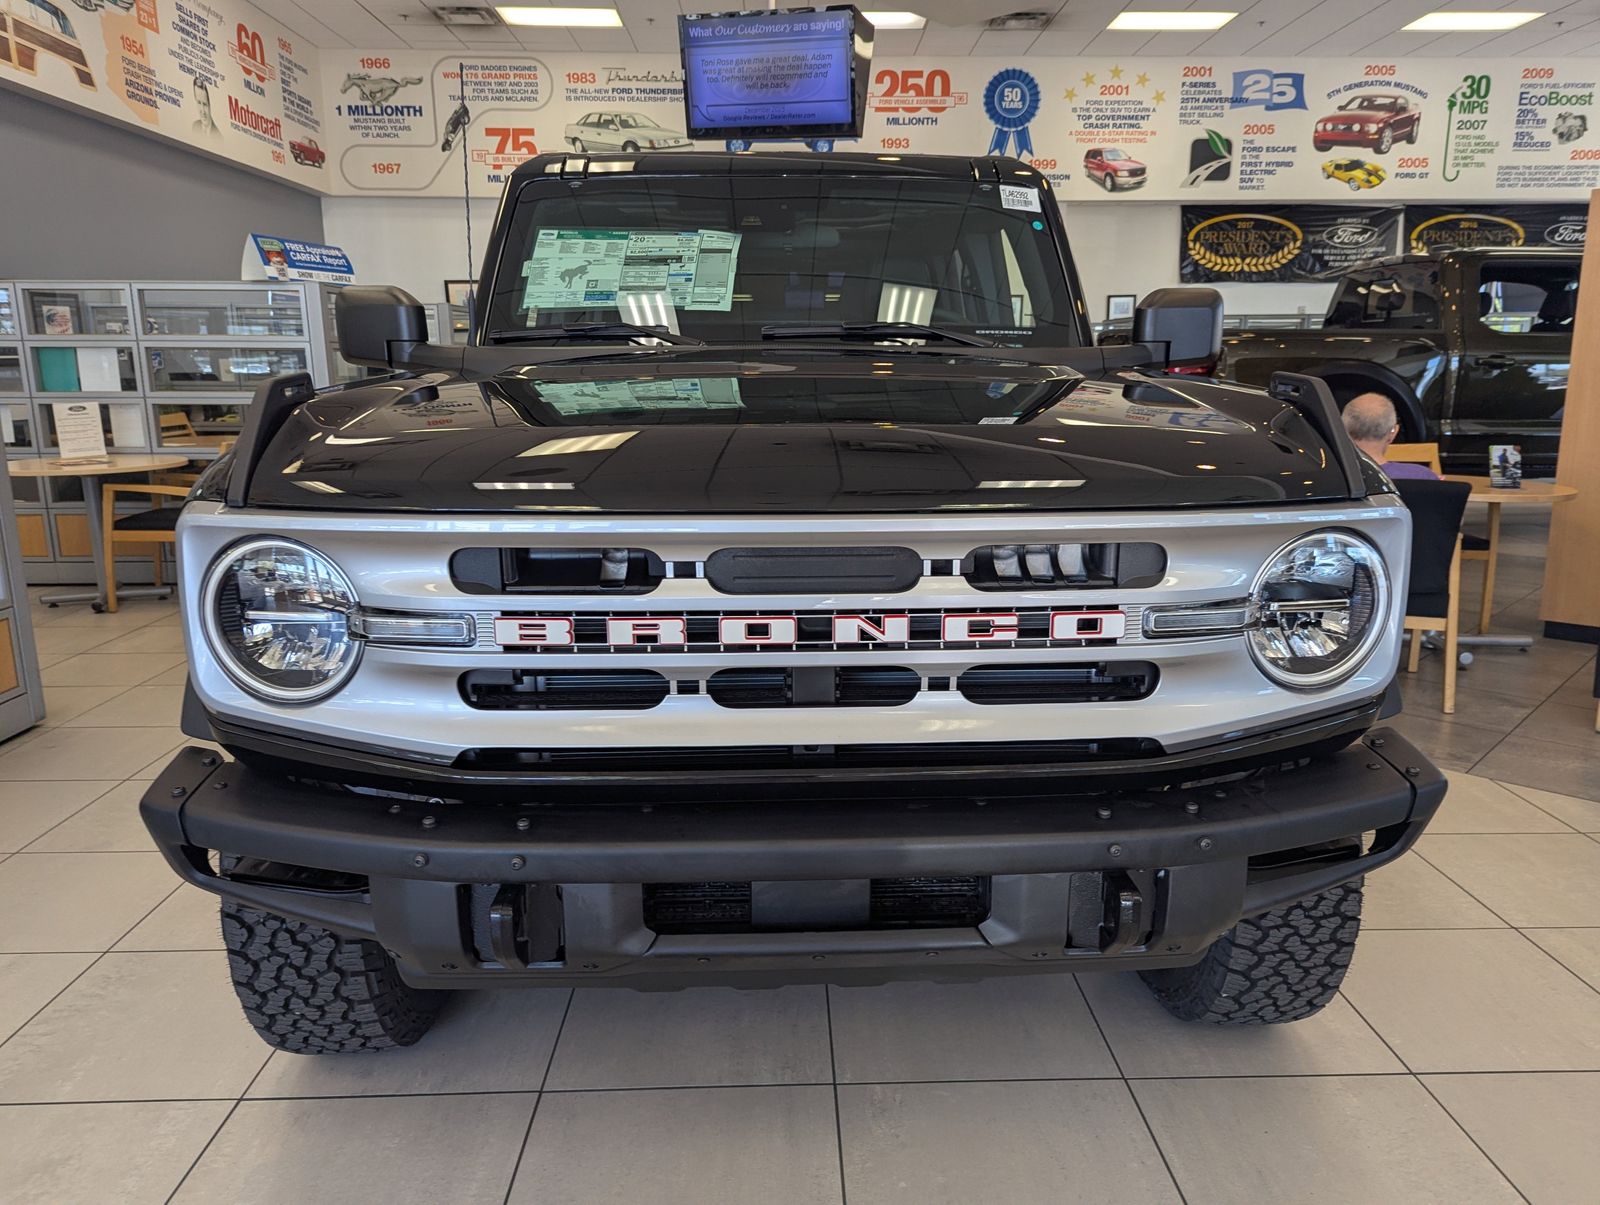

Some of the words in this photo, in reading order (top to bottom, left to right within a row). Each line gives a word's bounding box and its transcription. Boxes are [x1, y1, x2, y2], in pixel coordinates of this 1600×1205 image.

[175, 2, 194, 19] SELLS
[193, 13, 209, 28] FIRST
[178, 14, 200, 32] SHARES
[688, 26, 713, 38] What
[714, 25, 737, 37] Our
[737, 22, 792, 36] Customers
[793, 22, 809, 31] are
[809, 18, 845, 33] saying!
[171, 21, 198, 41] COMMON
[198, 36, 217, 52] STOCK
[120, 34, 145, 58] 1954
[236, 22, 266, 84] 60
[121, 55, 137, 69] FORD
[137, 61, 157, 77] BEGINS
[359, 57, 391, 69] 1966
[734, 57, 752, 67] gave
[752, 56, 764, 65] me
[771, 54, 791, 66] great
[810, 52, 833, 62] Adam
[122, 66, 142, 81] CRASH
[178, 62, 198, 78] HENRY
[198, 70, 213, 85] FORD
[703, 68, 717, 76] was
[717, 66, 737, 77] great
[745, 64, 773, 75] making
[773, 63, 786, 72] the
[786, 62, 803, 71] deal
[803, 61, 832, 72] happen
[721, 73, 755, 83] Definitely
[755, 73, 769, 81] will
[769, 71, 814, 81] recommend
[813, 70, 829, 79] and
[1182, 66, 1214, 78] 2001
[1364, 65, 1397, 77] 2005
[1522, 67, 1555, 79] 2009
[565, 72, 597, 84] 1983
[1181, 81, 1217, 89] F-SERIES
[125, 77, 153, 98] ARIZONA
[154, 89, 181, 108] PROVING
[243, 78, 266, 98] MILLION
[745, 82, 760, 90] will
[760, 82, 770, 90] be
[874, 68, 952, 113] 250
[1100, 84, 1130, 96] 2001
[1241, 73, 1297, 104] 25
[1326, 88, 1343, 100] 5TH
[1342, 80, 1392, 92] GENERATION
[1393, 81, 1429, 99] MUSTANG
[1461, 74, 1492, 100] 30
[126, 88, 160, 110] GROUNDS.
[1003, 87, 1022, 102] 50
[1518, 91, 1594, 106] EcoBoost
[335, 105, 342, 116] 1
[346, 104, 423, 117] MILLIONTH
[1001, 101, 1023, 109] YEARS
[1458, 100, 1490, 115] MPG
[227, 94, 283, 142] Motorcraft
[1516, 108, 1538, 119] 20%
[885, 117, 938, 126] MILLIONTH
[1456, 119, 1488, 131] 2007
[1243, 124, 1276, 135] 2005
[1514, 131, 1535, 141] 15%
[484, 127, 539, 171] 75
[880, 137, 910, 149] 1993
[1512, 141, 1552, 149] REDUCED
[271, 149, 286, 165] 1961
[1569, 149, 1600, 161] 2008
[371, 162, 402, 174] 1967
[1397, 158, 1430, 169] 2005
[1236, 221, 1255, 229] 2017
[1200, 230, 1293, 243] PRESIDENT'S
[1333, 227, 1373, 244] Ford
[284, 242, 306, 253] FREE
[1221, 242, 1271, 256] AWARD
[290, 251, 323, 264] CARFAX
[323, 255, 348, 267] Report
[297, 270, 314, 279] SHOW
[330, 274, 353, 283] CARFAX
[494, 610, 1127, 645] BRONCO
